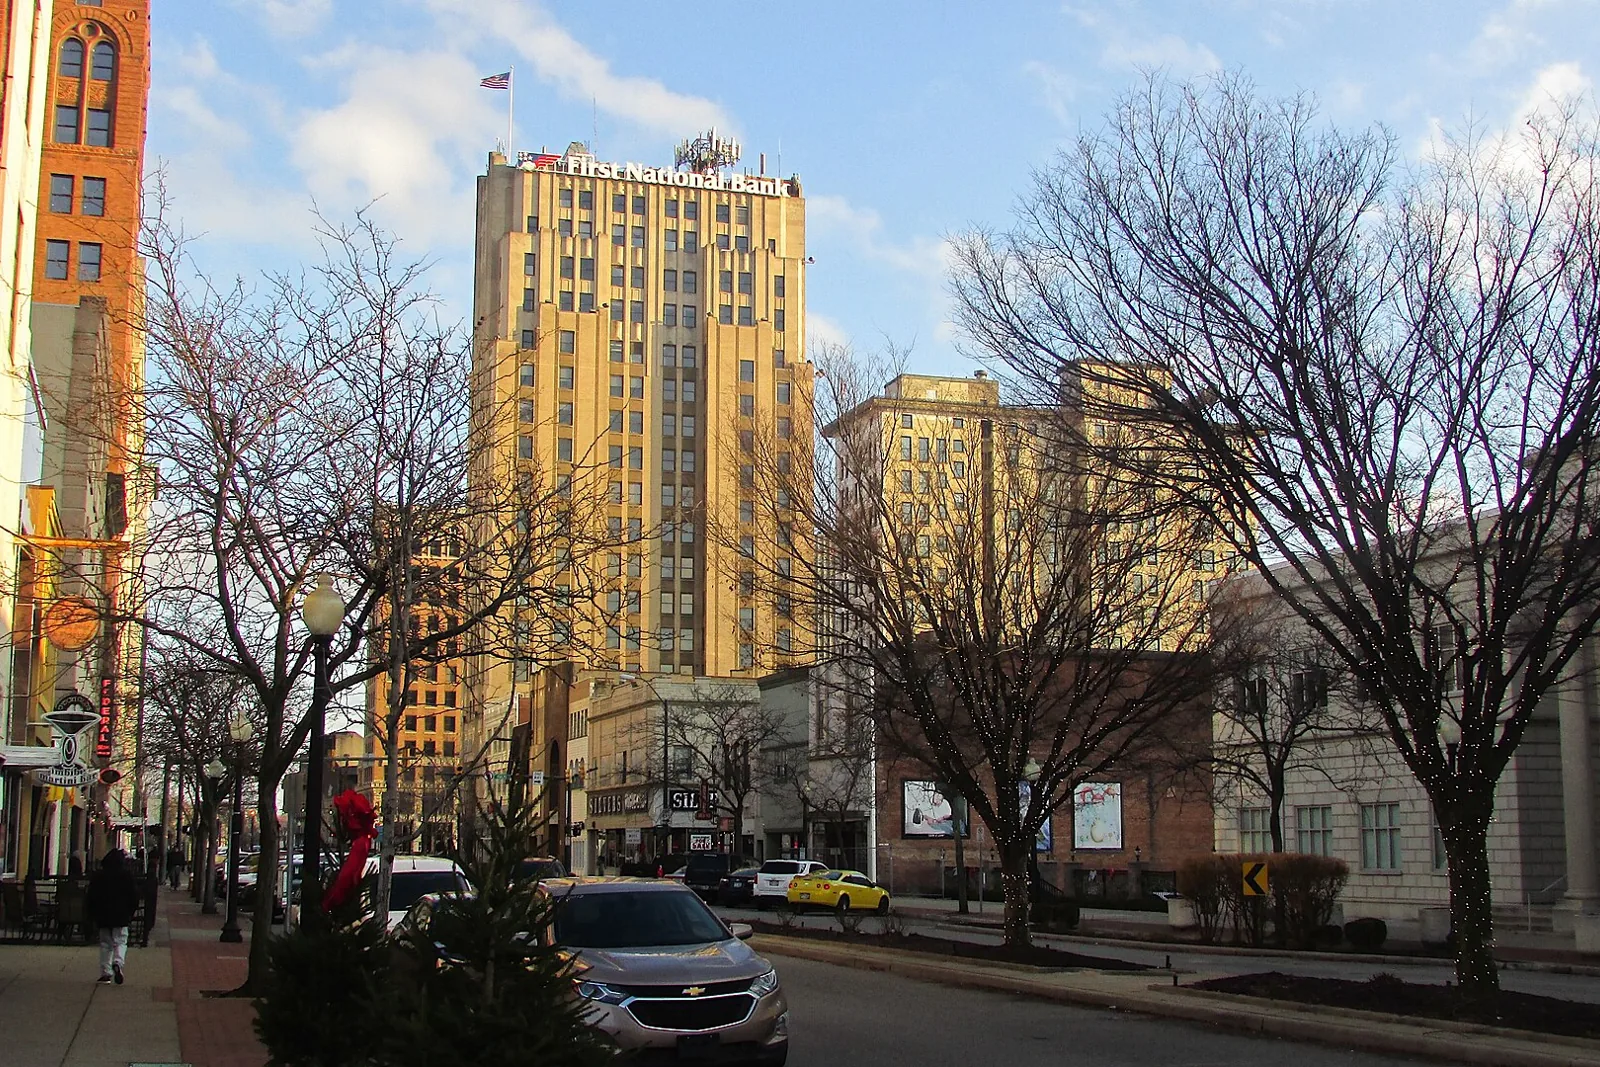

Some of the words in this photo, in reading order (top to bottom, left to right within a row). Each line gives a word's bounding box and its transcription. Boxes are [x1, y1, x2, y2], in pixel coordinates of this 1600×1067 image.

[568, 156, 618, 179] First
[625, 163, 727, 190] National
[729, 173, 791, 197] Bank
